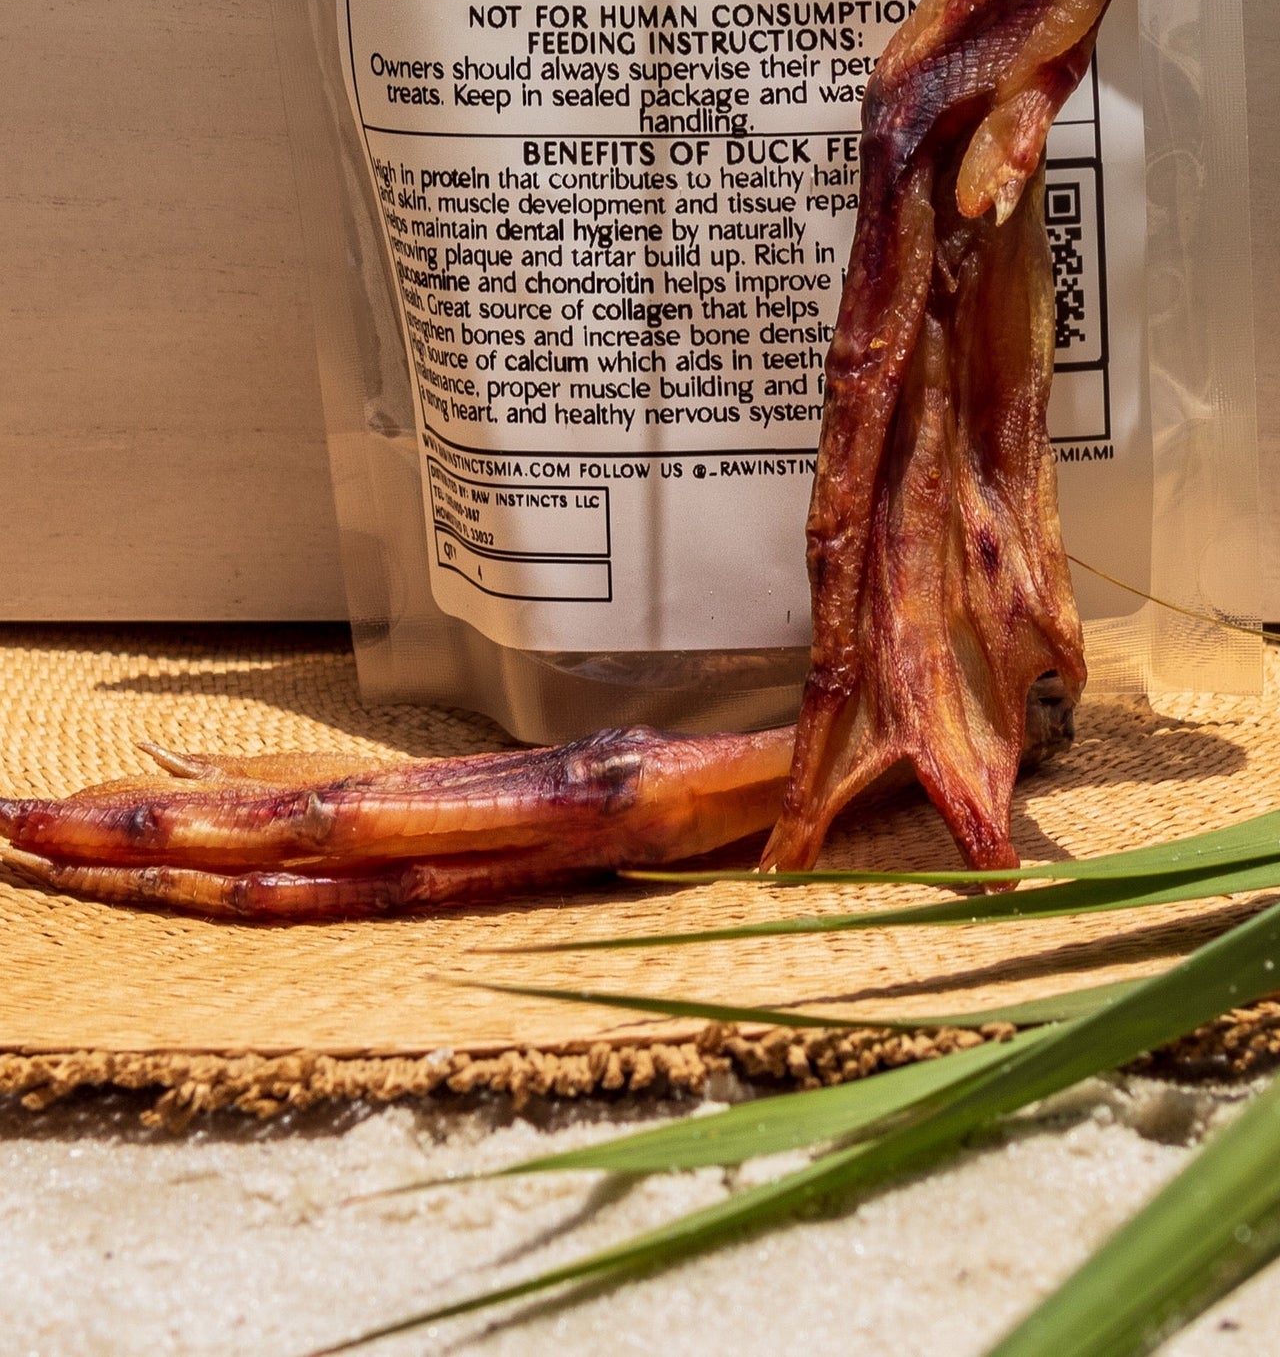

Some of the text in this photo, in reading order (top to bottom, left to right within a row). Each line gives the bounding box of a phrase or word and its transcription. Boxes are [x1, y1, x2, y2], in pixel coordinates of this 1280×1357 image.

[469, 5, 697, 29] NOT FOR HUMAN
[528, 28, 863, 55] FEEDING INSTRUCTIONS:
[370, 53, 820, 88] Owners should always supervise their
[387, 81, 807, 114] treats. Keep in sealed package and
[640, 109, 754, 138] handling.
[524, 139, 811, 166] BENEFITS OF DUCK
[400, 163, 414, 186] in
[421, 166, 490, 194] protein
[498, 167, 540, 190] that
[548, 166, 678, 190] contributes
[687, 171, 711, 189] to
[720, 167, 804, 193] healthy
[438, 192, 796, 221] muscle development and tissue
[411, 216, 806, 248] maintain dental hygiene by naturally
[445, 242, 835, 272] plaque and tartar build up. Rich in
[478, 271, 517, 293] and
[525, 271, 654, 294] chondroitin
[664, 272, 726, 300] helps
[736, 271, 831, 298] improve
[427, 293, 820, 328] Great source of collagen that helps
[462, 323, 750, 347] bones and increase bone
[427, 345, 822, 373] source of calcium which aids in teeth
[487, 380, 561, 405] proper
[570, 377, 651, 398] muscle
[660, 376, 753, 404] building
[764, 374, 807, 396] and
[507, 402, 740, 432] and healthy nervous
[580, 463, 683, 479] FOLLOW US
[471, 489, 489, 504] RAW
[496, 493, 567, 508] INSTINCTS
[575, 495, 599, 508] LLC
